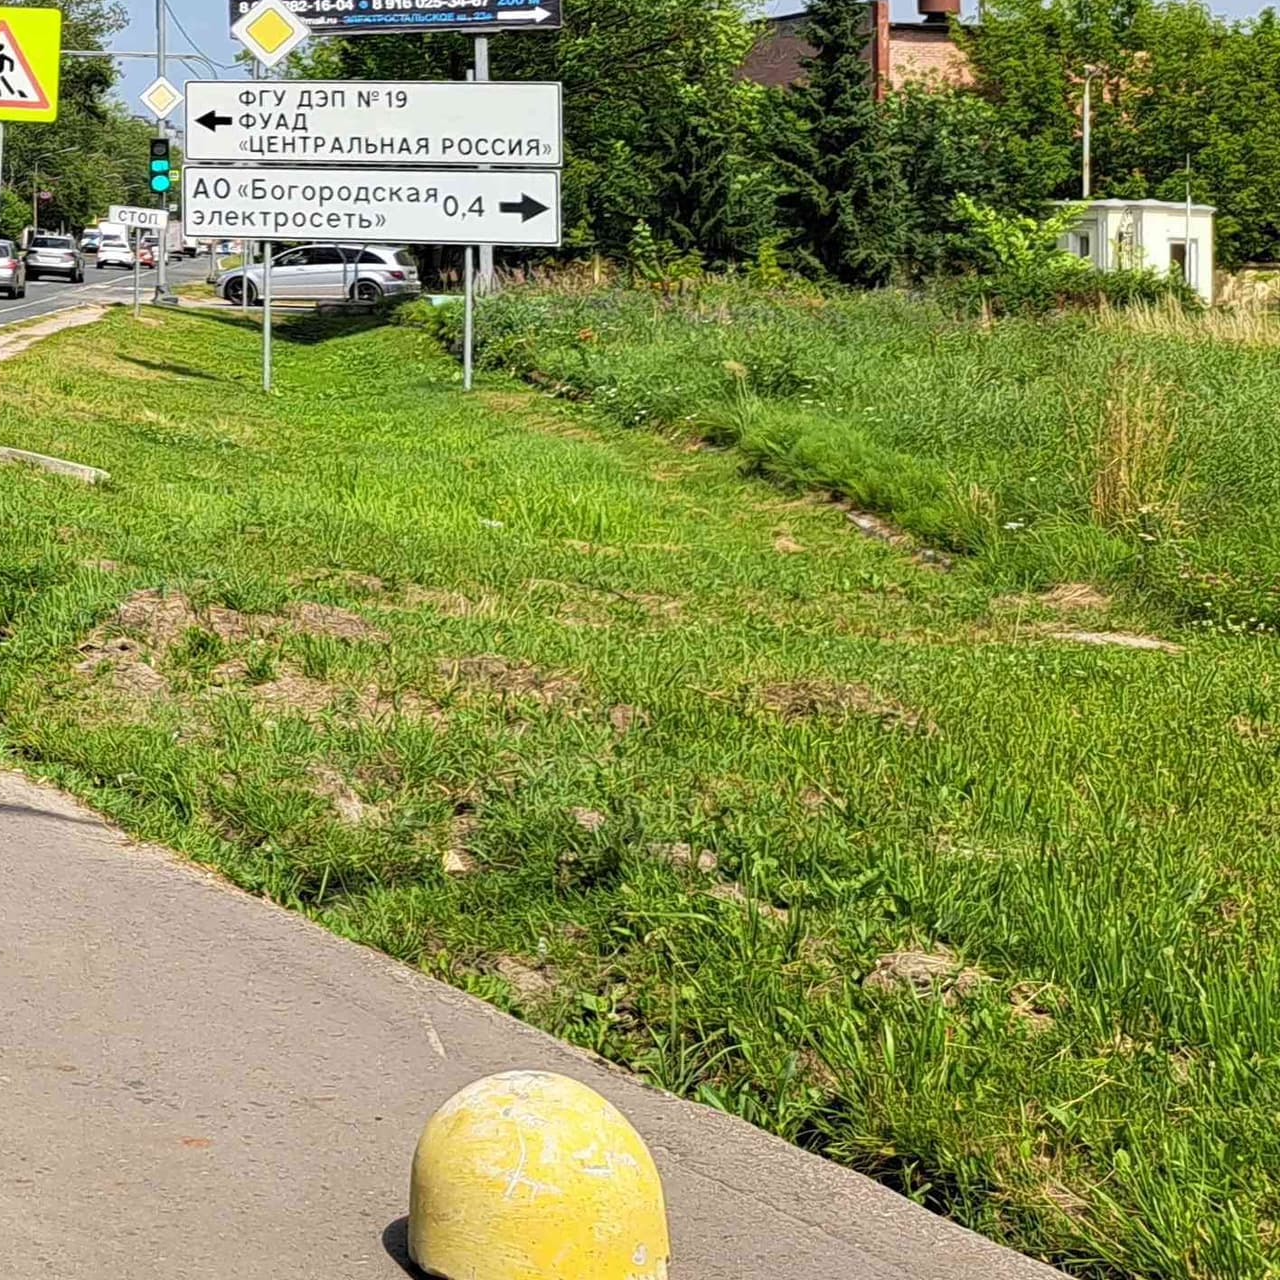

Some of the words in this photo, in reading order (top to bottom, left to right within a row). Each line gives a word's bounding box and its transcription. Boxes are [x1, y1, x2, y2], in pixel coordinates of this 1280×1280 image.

[238, 90, 286, 108] ФГУ
[297, 90, 346, 109] ДЭП
[238, 113, 308, 133] ФУАД
[239, 136, 430, 156] «ЦЕНТРАЛЬНАЯ
[441, 138, 552, 156] РОССИЯ»
[192, 177, 231, 200] АО
[238, 178, 439, 205] «Богородская
[443, 195, 485, 220] 0,4
[118, 210, 158, 224] СТОП
[192, 210, 387, 230] электросеть»
